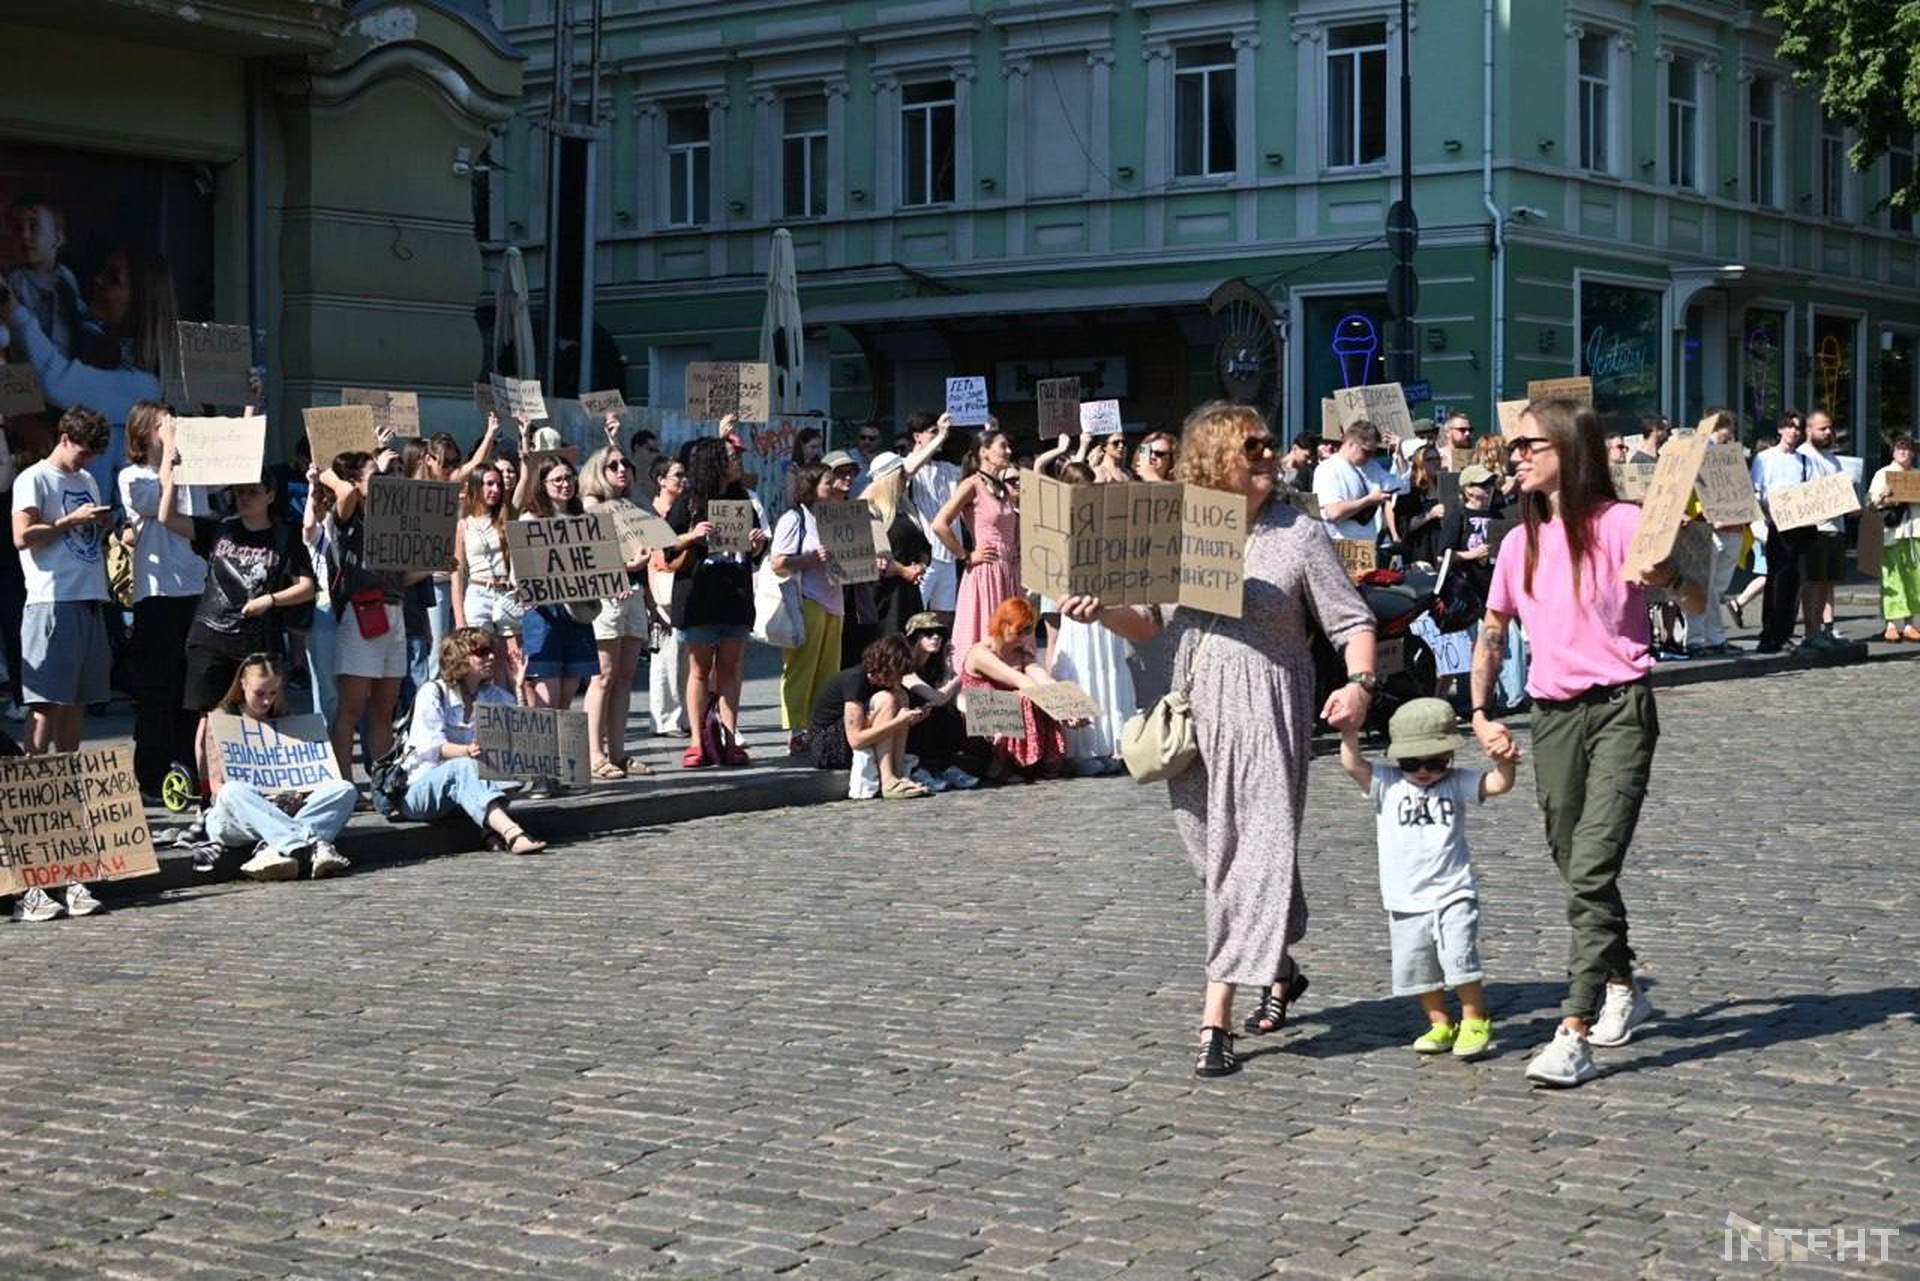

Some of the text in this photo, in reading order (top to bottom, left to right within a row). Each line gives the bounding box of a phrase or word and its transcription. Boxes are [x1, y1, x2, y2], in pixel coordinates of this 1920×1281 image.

[371, 482, 459, 517] РУКИ ГЕТЬ
[400, 515, 422, 532] ВІД
[367, 532, 456, 567] ФЕДОРОВА
[547, 547, 596, 573] А НЕ
[519, 573, 625, 601] ЗВІЛЬНЯТИ
[0, 751, 118, 783] МАДЯНИН
[220, 741, 328, 766] ЗВІЛЬНЕННЮ
[225, 764, 335, 787] ФЕДОРОВА
[1398, 796, 1455, 828] GAP
